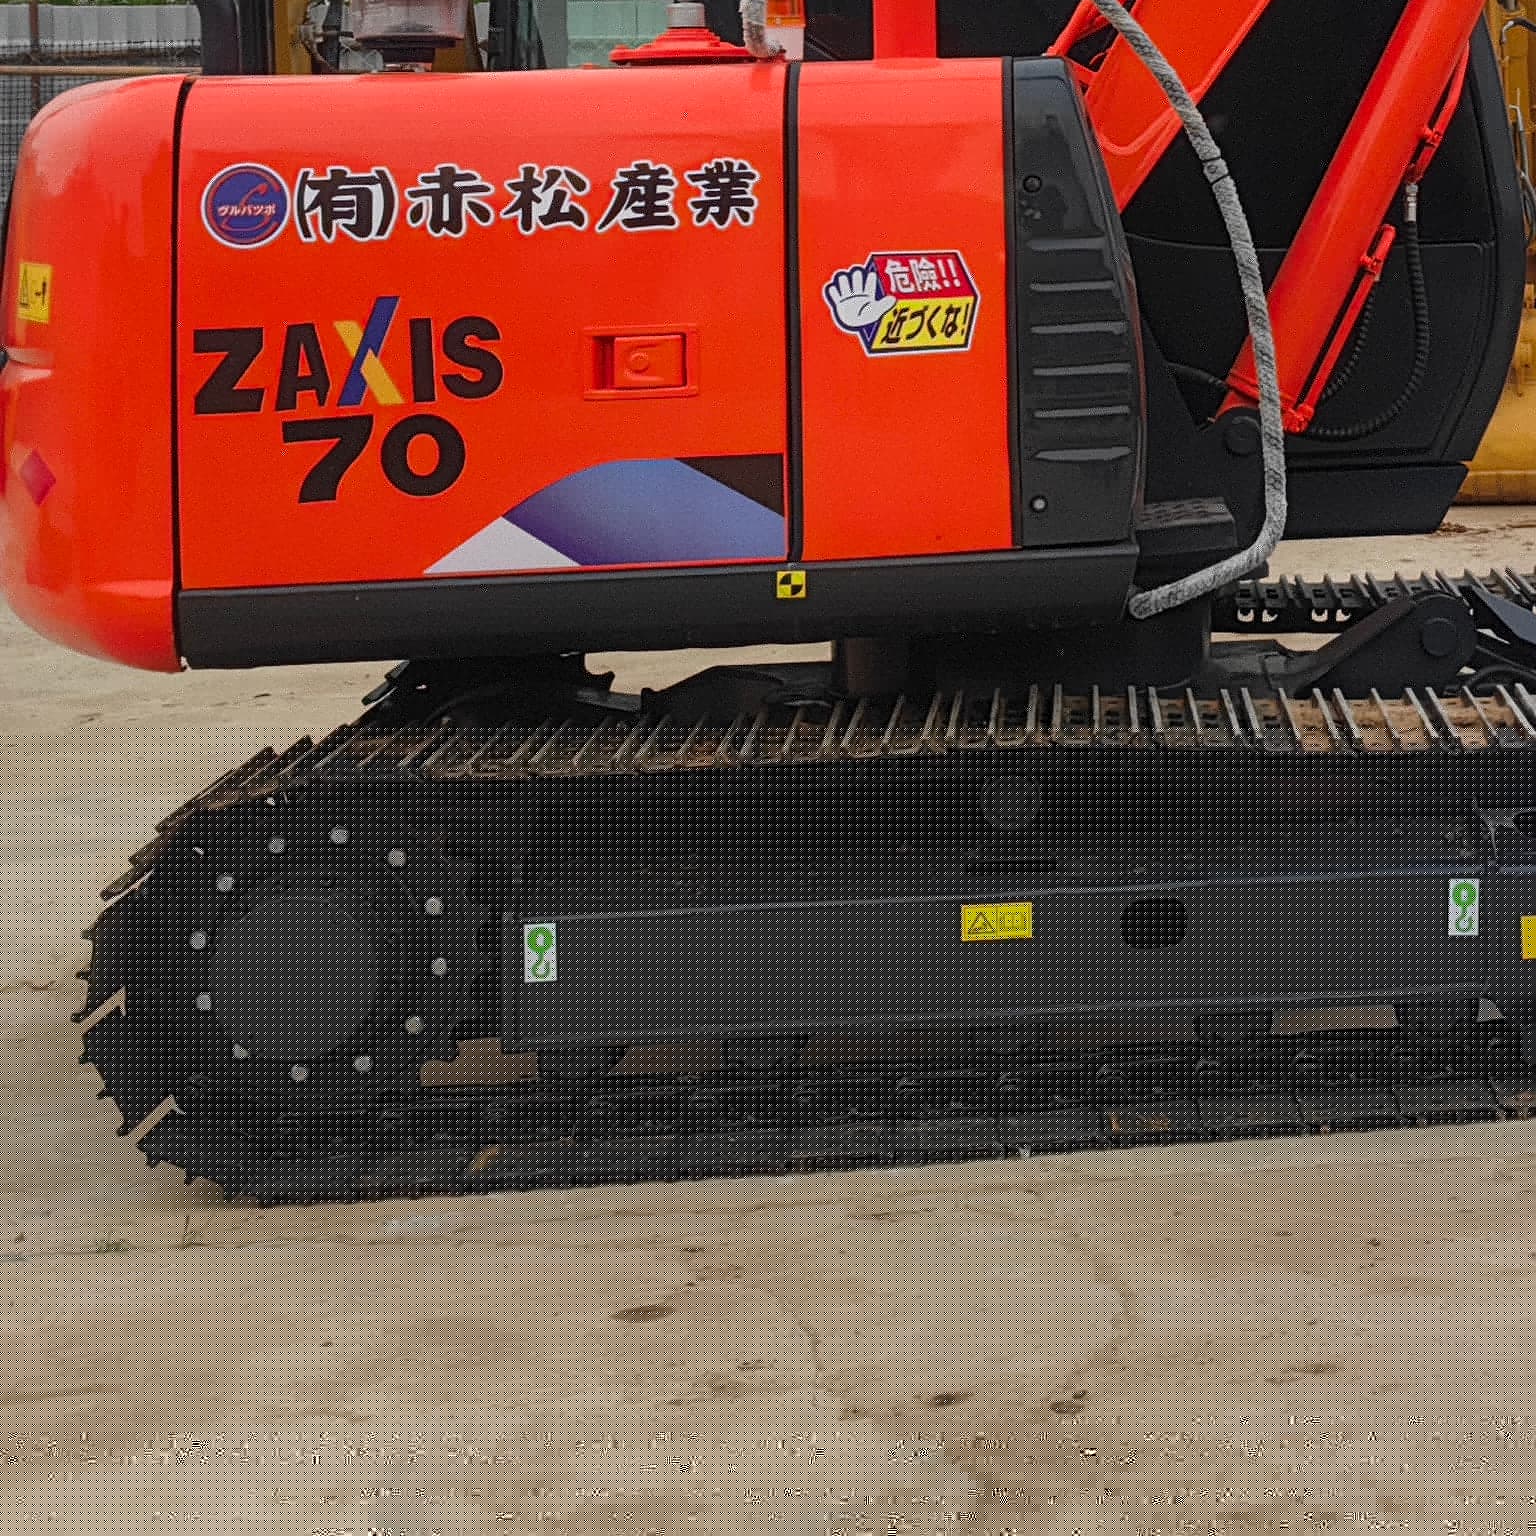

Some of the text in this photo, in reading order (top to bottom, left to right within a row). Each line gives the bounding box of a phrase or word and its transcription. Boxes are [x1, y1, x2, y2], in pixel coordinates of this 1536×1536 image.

[297, 159, 758, 241] (有)赤松産業
[193, 296, 504, 415] ZAXIS
[880, 302, 970, 344] 近づくな!
[281, 414, 466, 504] 70
